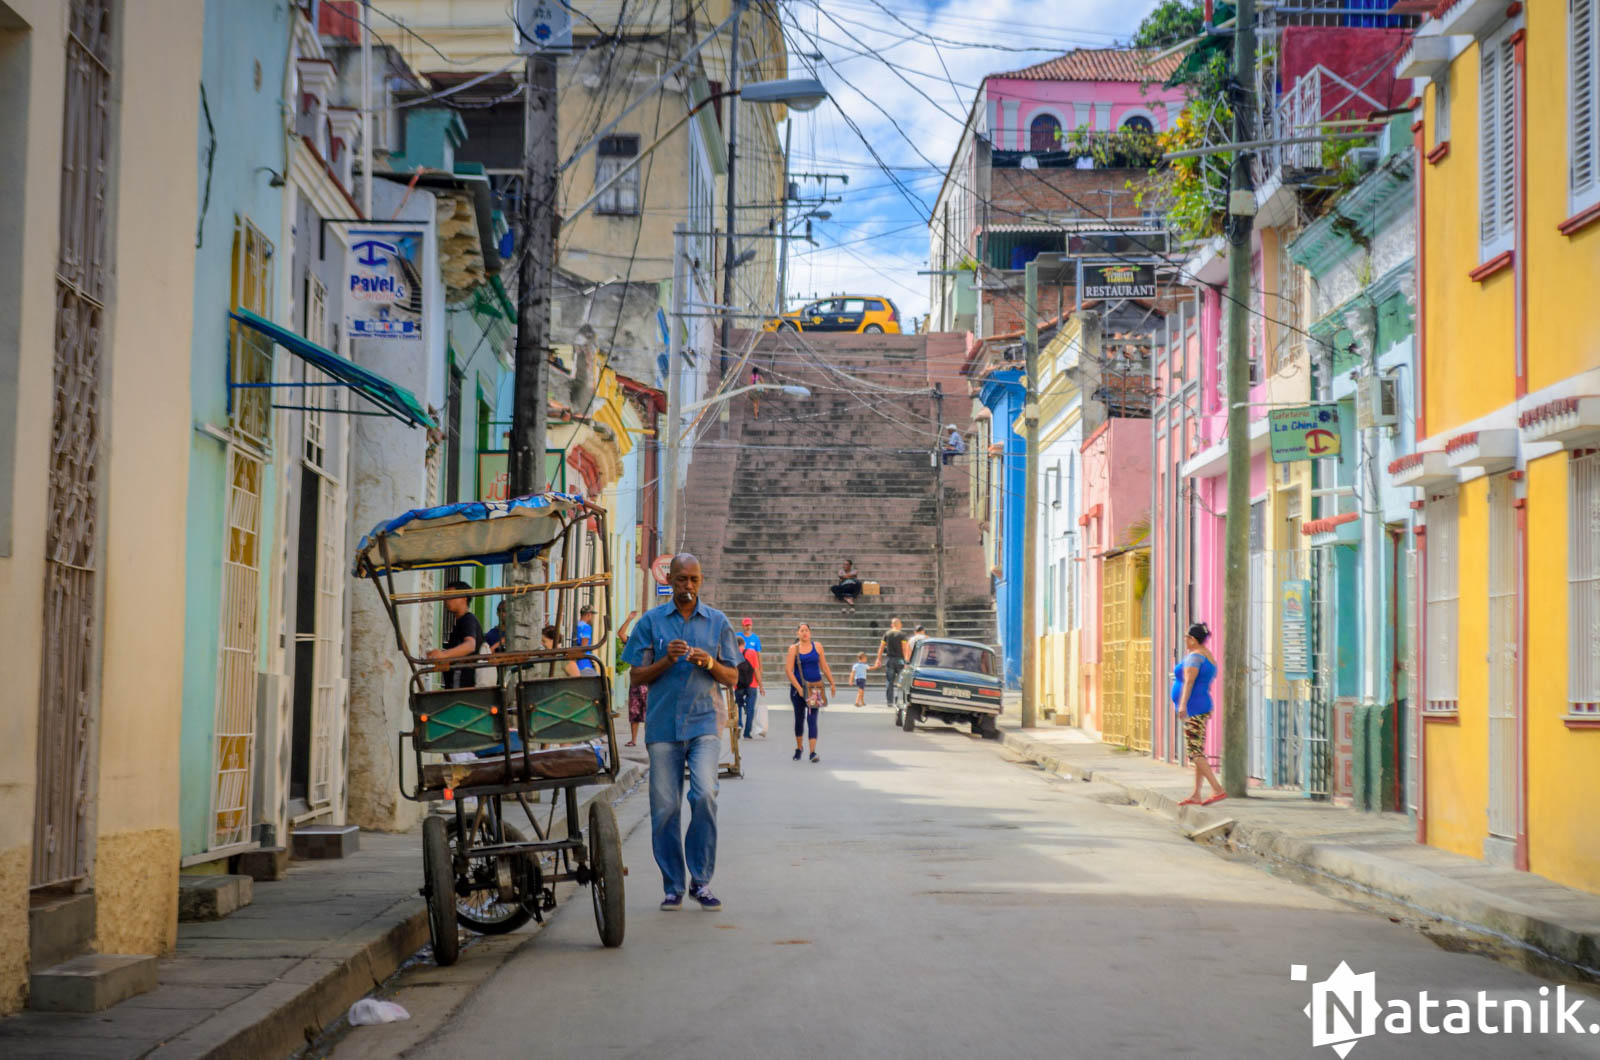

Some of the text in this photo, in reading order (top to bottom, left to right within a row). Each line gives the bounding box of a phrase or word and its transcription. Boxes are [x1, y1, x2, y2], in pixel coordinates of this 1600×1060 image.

[351, 275, 394, 292] Pavel
[1085, 285, 1155, 297] RESTAURANT
[1274, 420, 1318, 432] La China
